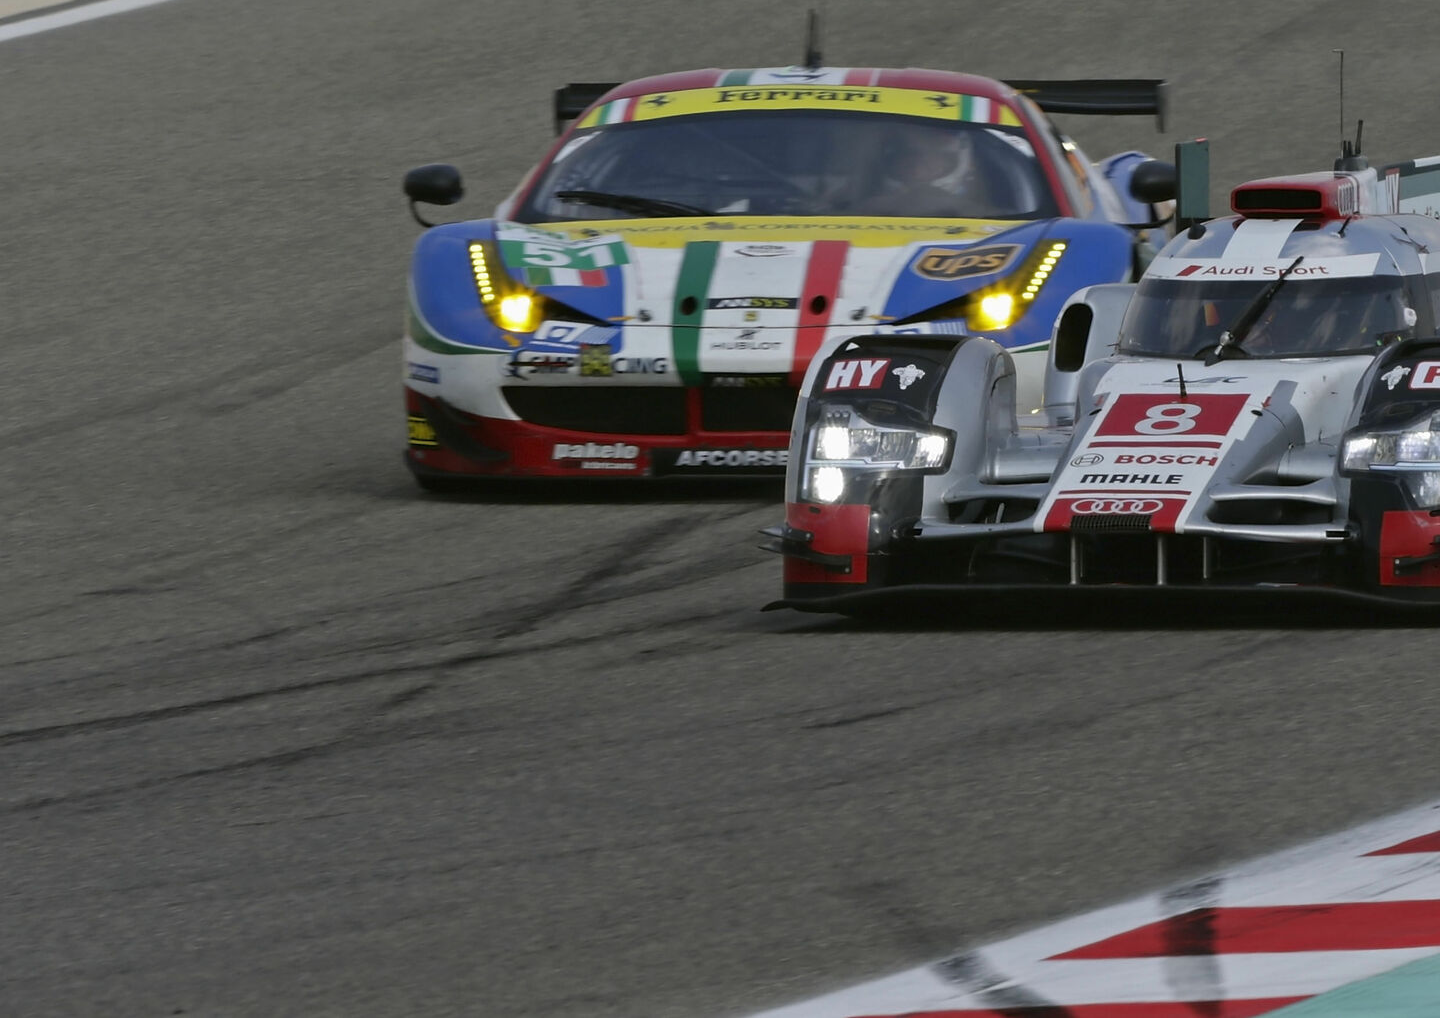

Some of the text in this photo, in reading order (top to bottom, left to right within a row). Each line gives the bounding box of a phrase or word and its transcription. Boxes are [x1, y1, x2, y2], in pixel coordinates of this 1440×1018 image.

[714, 88, 882, 104] Ferrari
[522, 241, 615, 268] 51
[1202, 265, 1329, 278] Audi Sport
[710, 341, 783, 350] HUBLOT
[825, 359, 888, 390] HY
[1134, 403, 1202, 435] 8
[552, 442, 640, 460] pakelo
[1113, 454, 1219, 467] BOSCH
[1079, 473, 1184, 485] MAHLE
